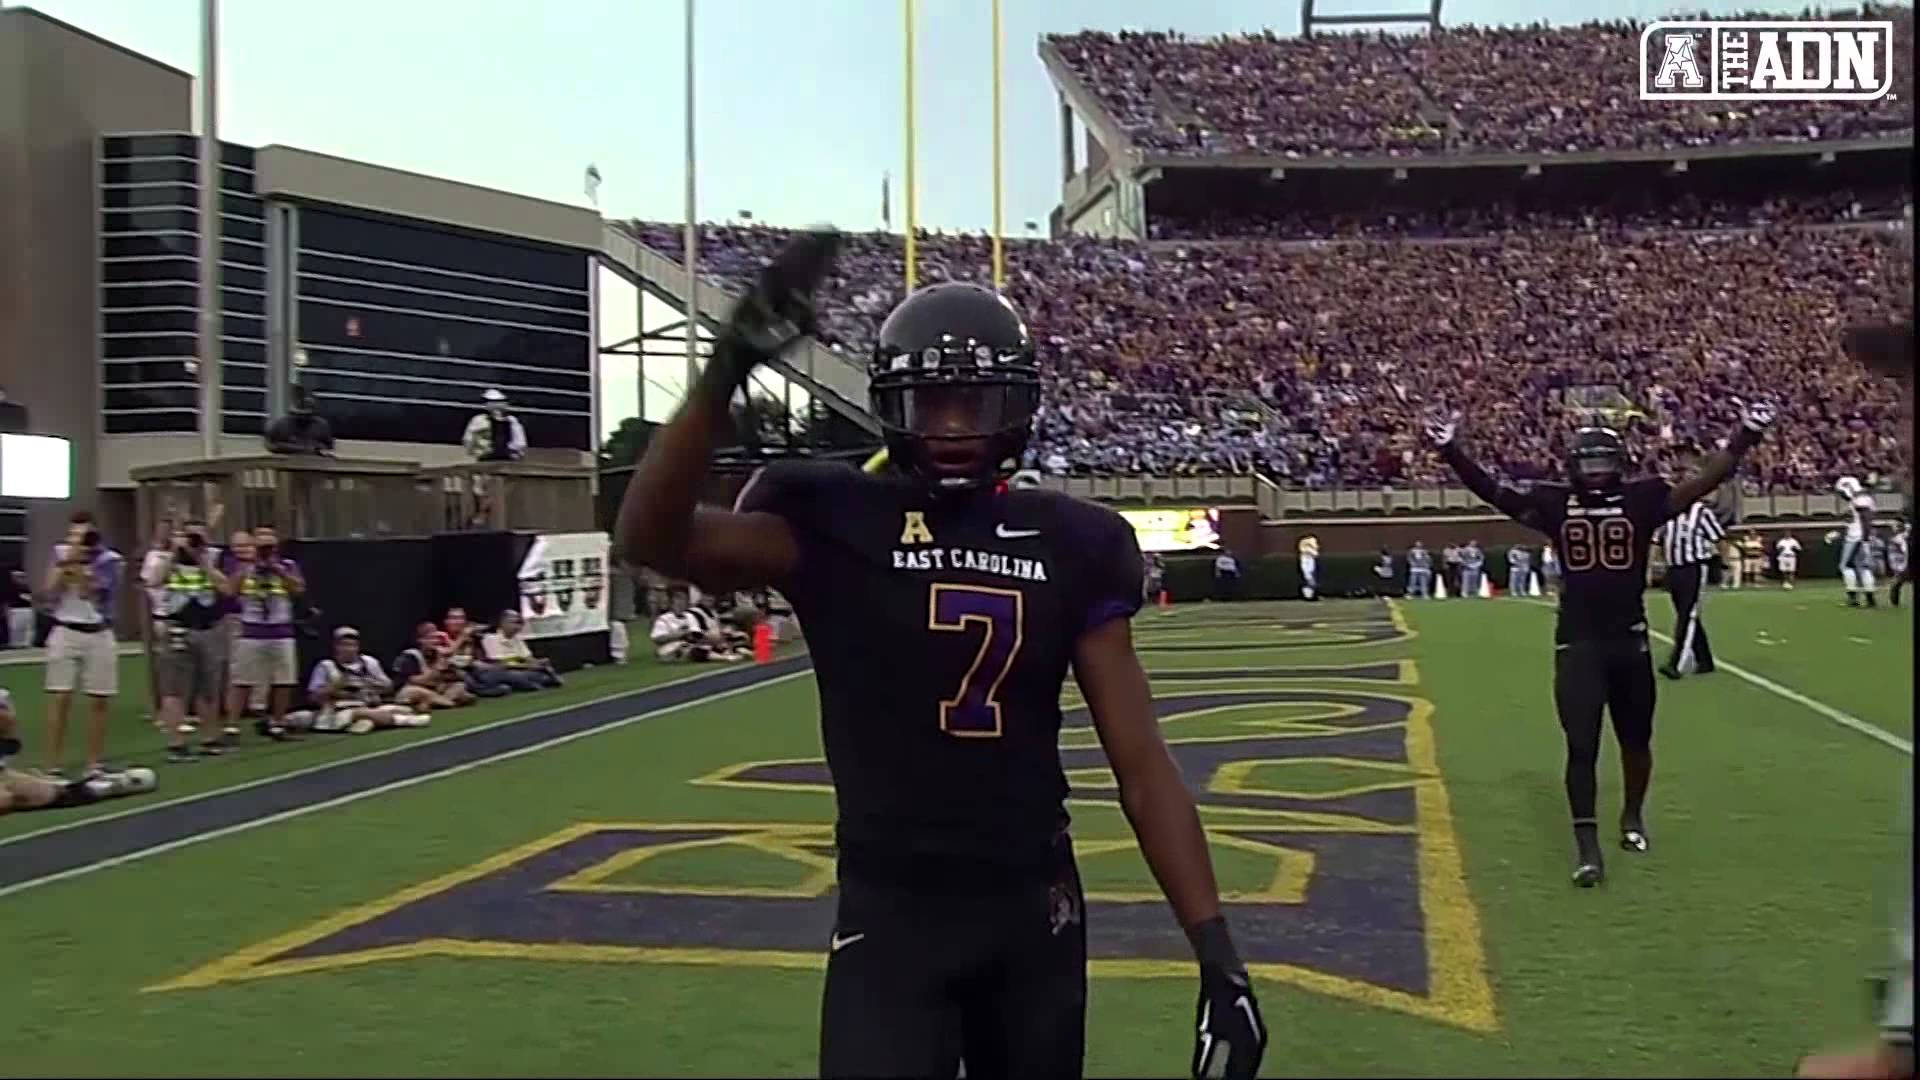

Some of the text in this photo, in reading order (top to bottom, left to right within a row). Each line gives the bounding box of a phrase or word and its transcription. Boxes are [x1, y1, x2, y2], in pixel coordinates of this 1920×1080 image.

[900, 511, 934, 544] A
[1561, 517, 1635, 571] 88
[892, 549, 1048, 581] EAST CAROLINA
[929, 582, 1024, 737] 7
